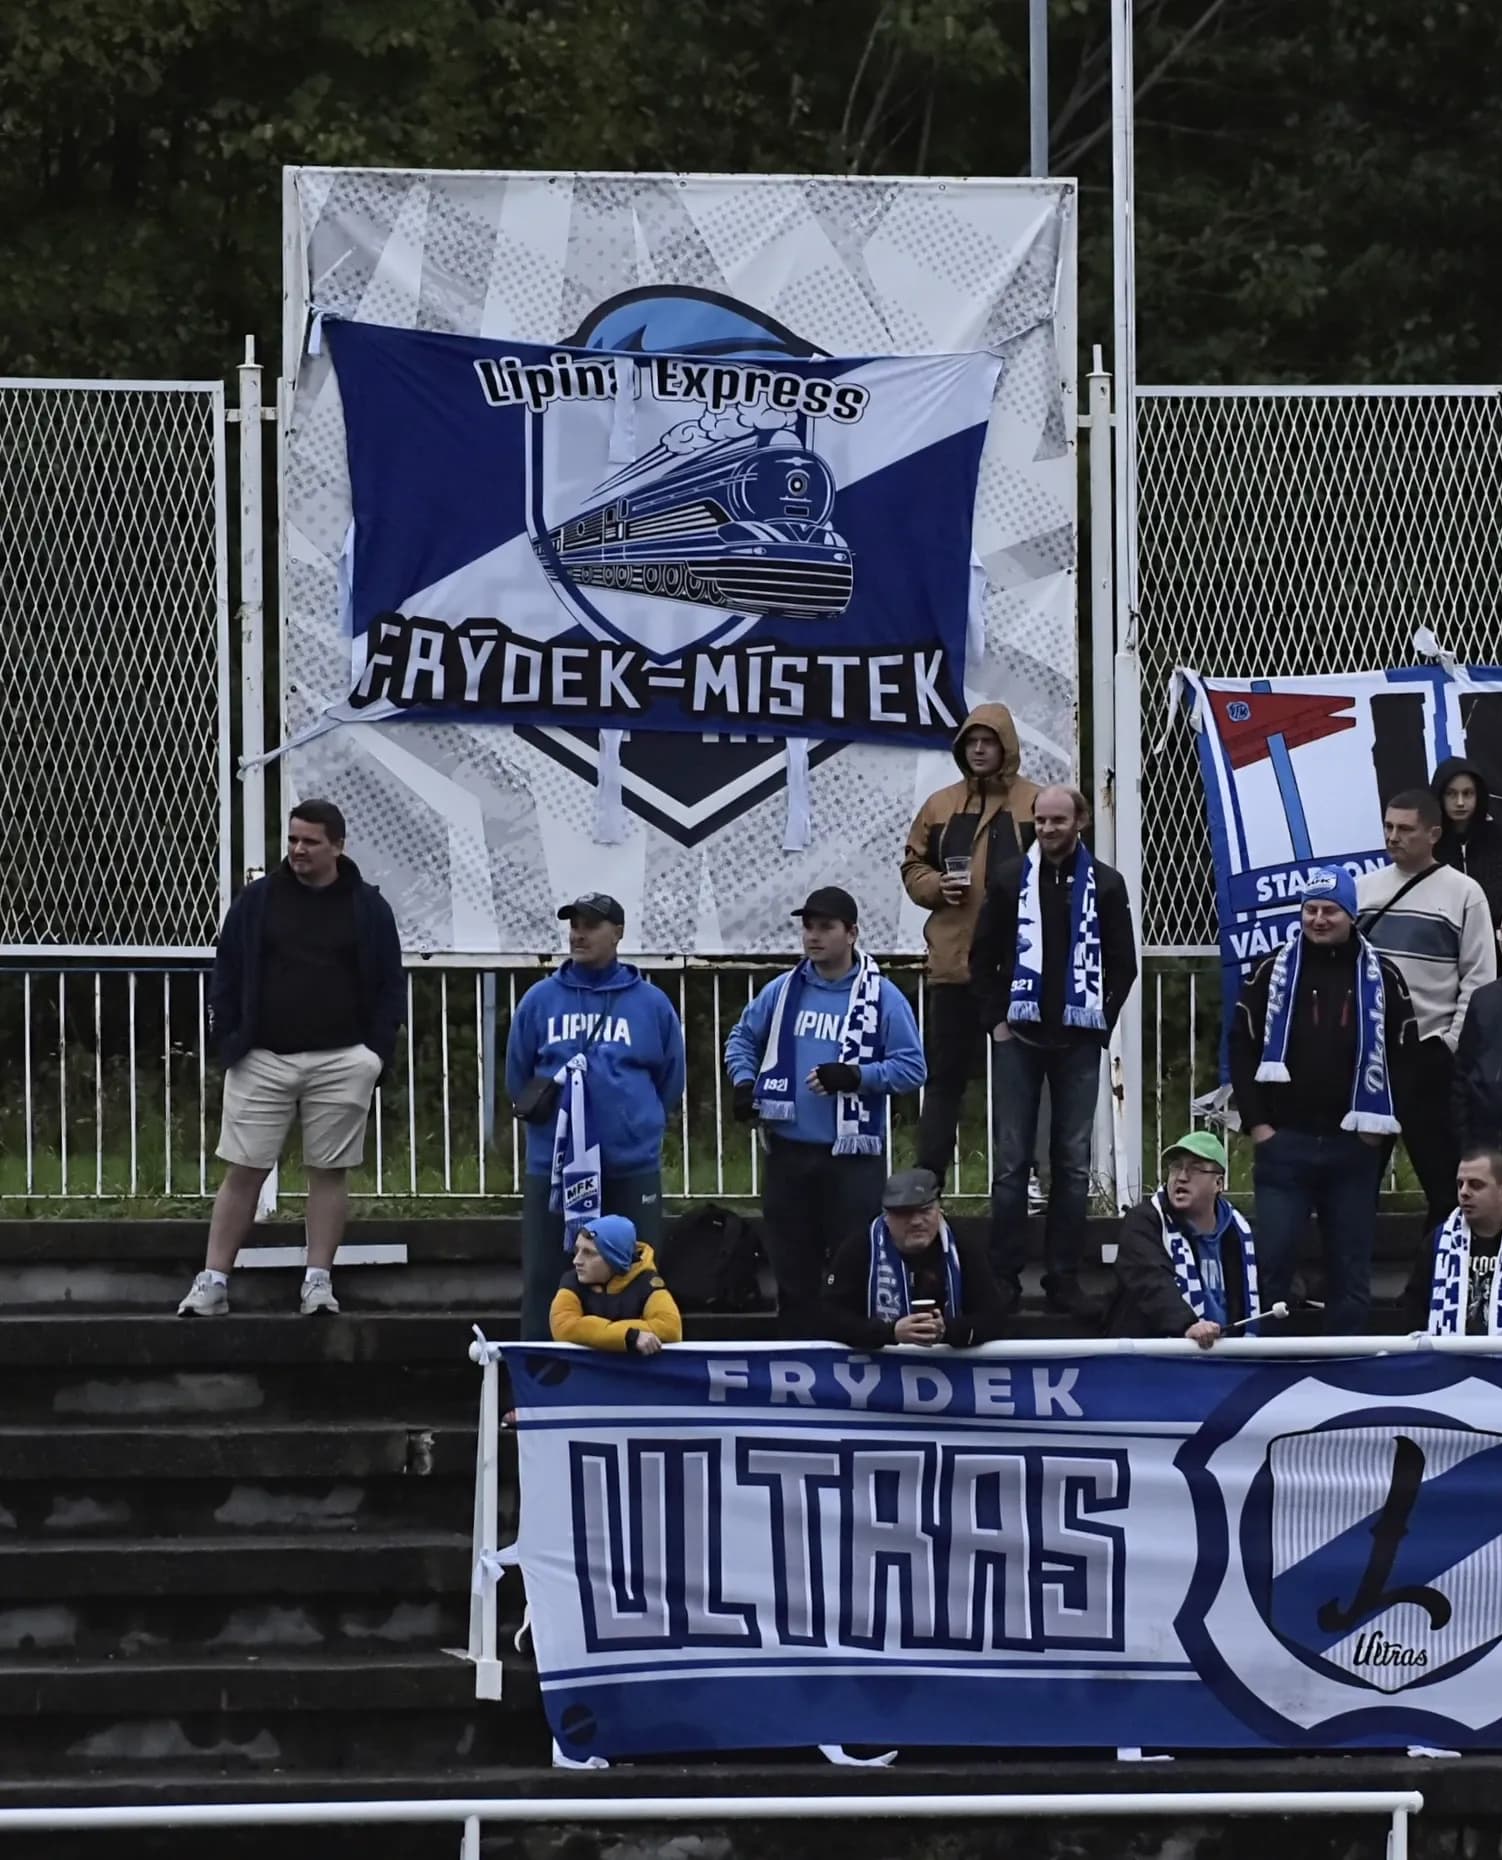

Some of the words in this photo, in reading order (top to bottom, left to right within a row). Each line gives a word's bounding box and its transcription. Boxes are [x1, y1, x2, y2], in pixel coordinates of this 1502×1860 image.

[653, 358, 870, 424] Express
[1256, 857, 1385, 903] STAON
[1010, 978, 1033, 993] 921
[547, 1012, 632, 1047] LIPINA
[794, 1010, 851, 1042] IPIN
[763, 1077, 788, 1092] 1921
[566, 1177, 595, 1200] MFK
[706, 1354, 1085, 1418] FRÝDEK
[569, 1436, 1130, 1654] ULTRAS
[1352, 1629, 1428, 1668] Ultras
